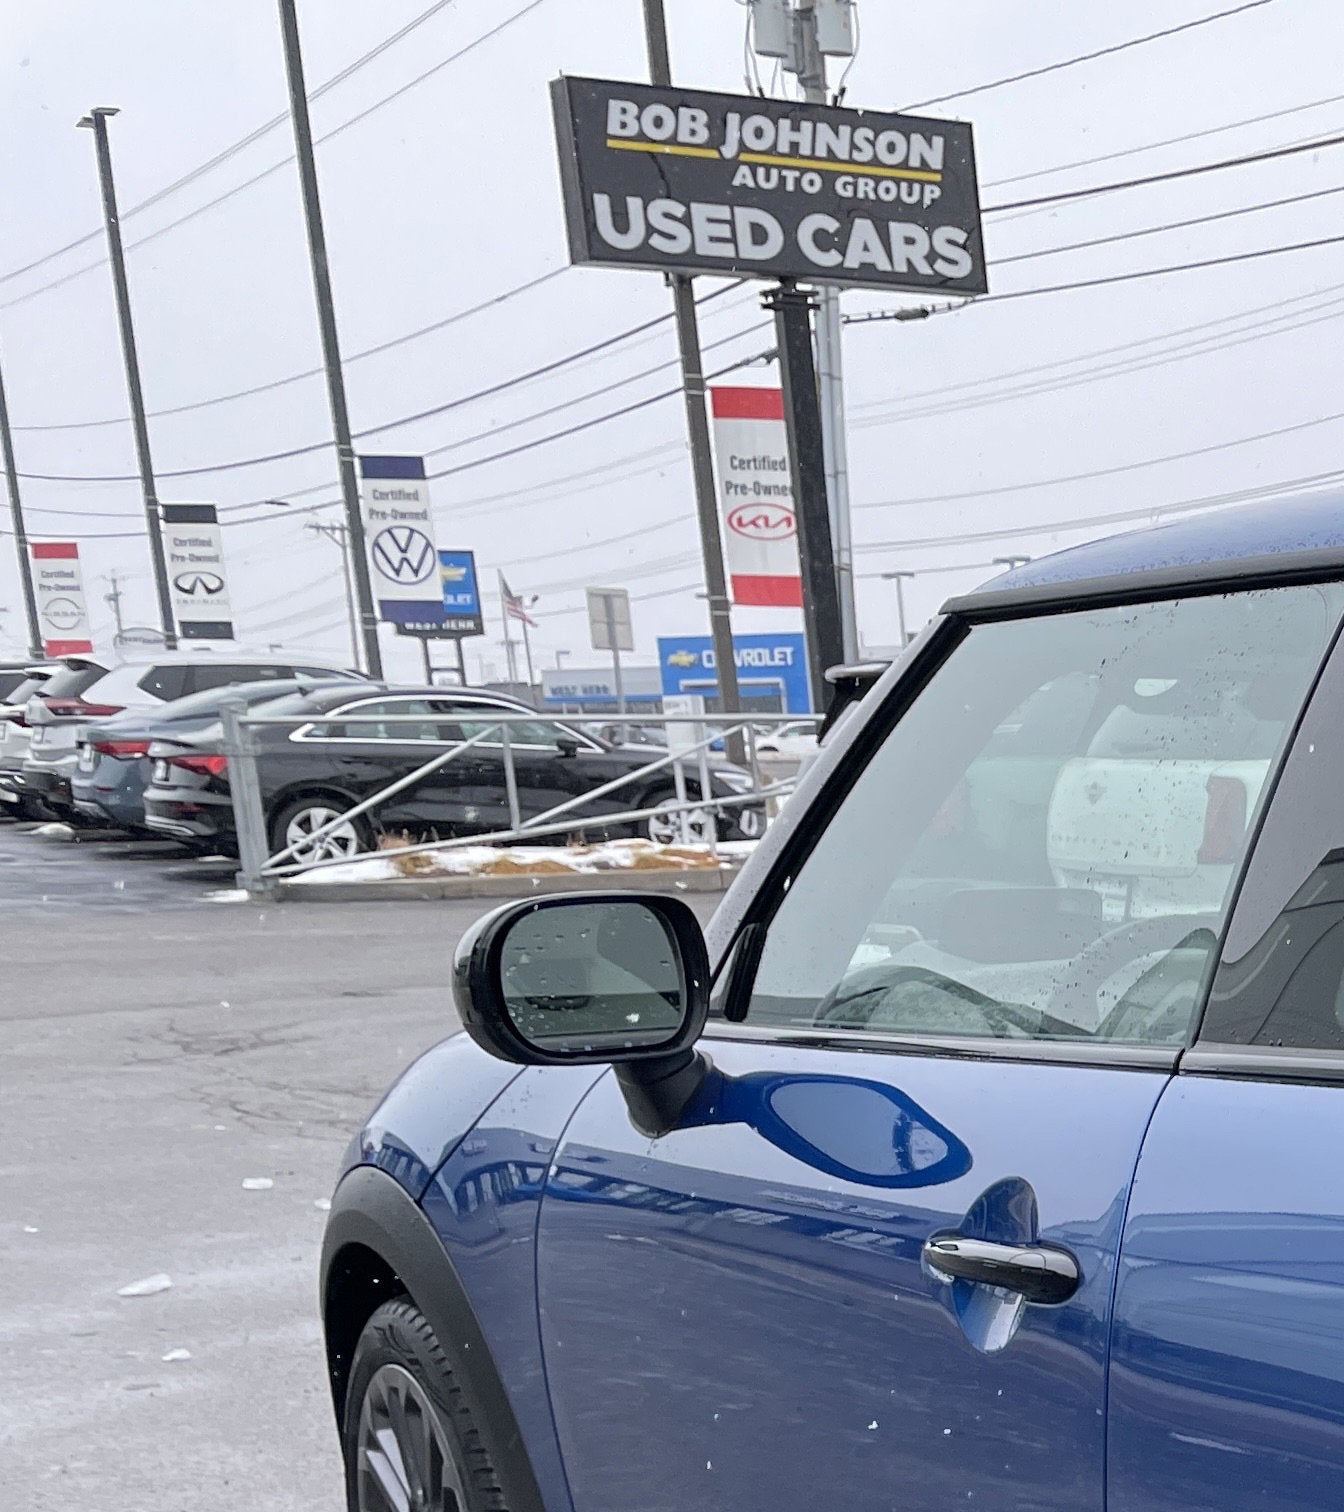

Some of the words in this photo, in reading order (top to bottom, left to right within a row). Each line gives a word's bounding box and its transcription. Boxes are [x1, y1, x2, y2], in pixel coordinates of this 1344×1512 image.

[607, 98, 709, 144] BOB
[719, 112, 945, 170] JOHNSON
[732, 164, 823, 195] AUTO
[834, 174, 942, 208] GROUP
[592, 192, 785, 261] USED
[796, 211, 974, 279] CARS
[729, 454, 787, 471] Certified
[372, 488, 419, 501] Certified
[725, 480, 792, 496] Pre-Owne
[368, 508, 428, 521] Pre-Owned
[702, 646, 795, 668] CVROLET
